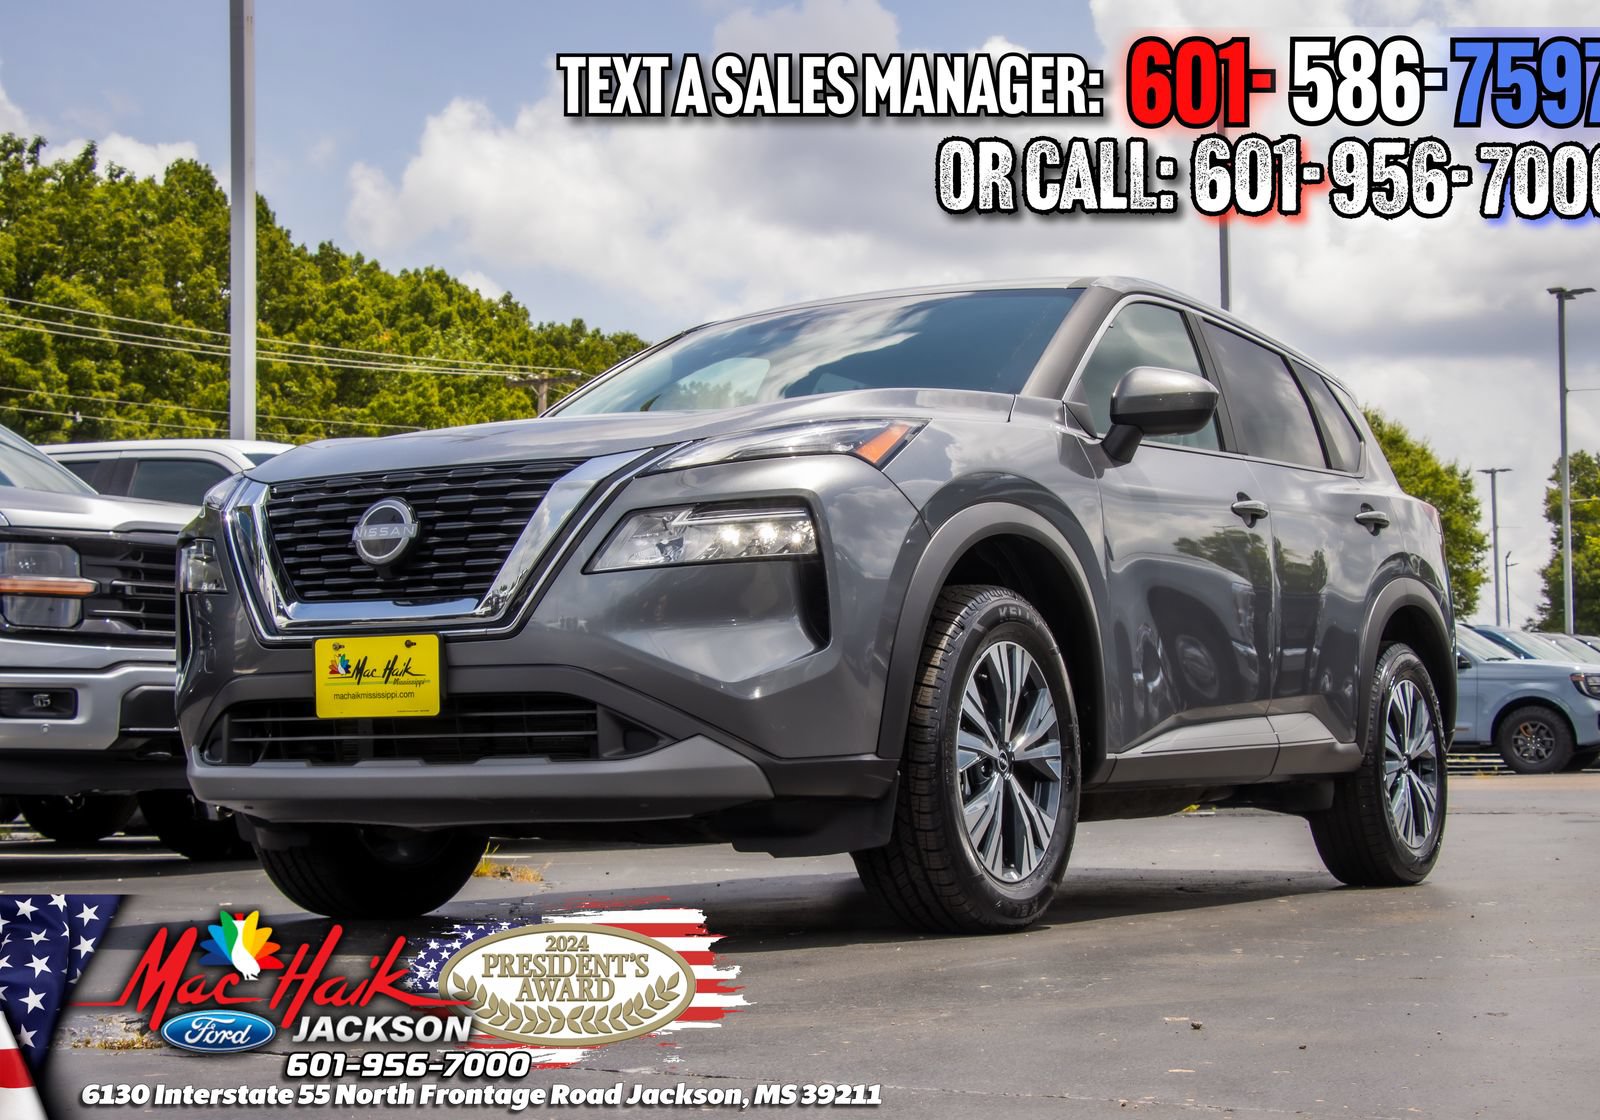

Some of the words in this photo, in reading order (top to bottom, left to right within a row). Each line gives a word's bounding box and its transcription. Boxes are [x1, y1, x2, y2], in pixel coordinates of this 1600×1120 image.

[353, 525, 416, 539] NISSAN
[342, 656, 377, 685] Mac
[382, 655, 418, 684] Haik
[333, 690, 415, 701] machaikmississippi.com
